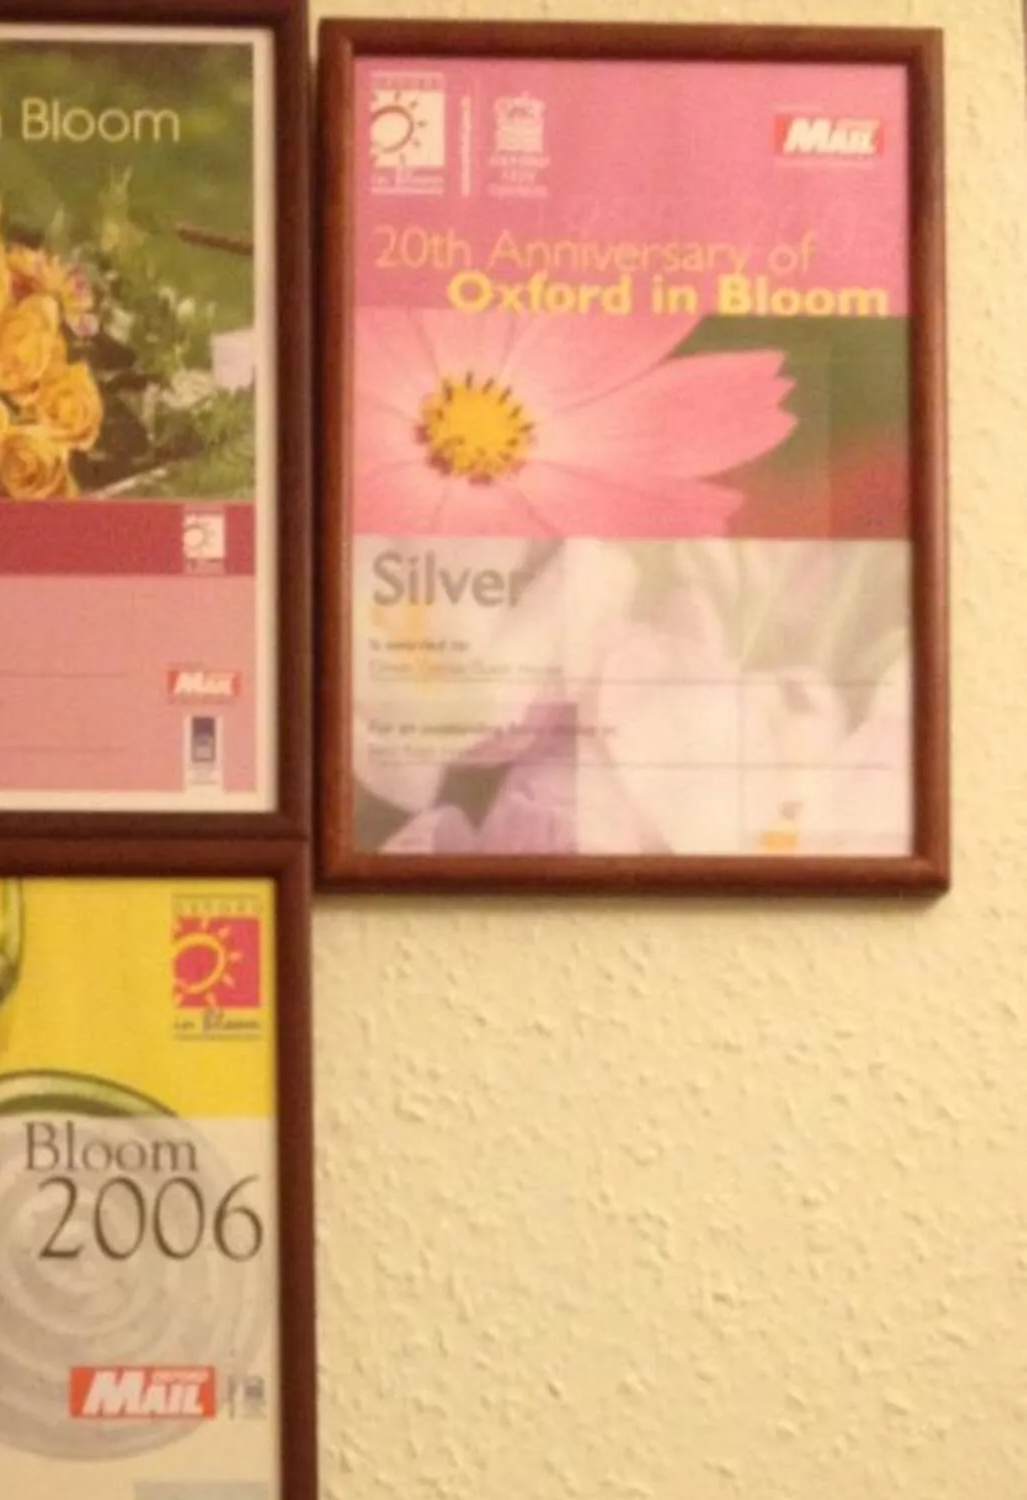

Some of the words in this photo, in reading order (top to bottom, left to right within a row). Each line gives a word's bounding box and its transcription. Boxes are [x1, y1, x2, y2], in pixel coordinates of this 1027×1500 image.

[21, 97, 181, 143] Bloom
[376, 226, 471, 270] 20th
[487, 229, 747, 277] Anniversary
[768, 231, 819, 274] of
[447, 269, 632, 316] Oxford
[652, 273, 696, 316] in
[718, 273, 890, 318] Bloom
[372, 550, 537, 609] Silver
[24, 1119, 200, 1174] Bloom
[37, 1174, 265, 1263] 2006
[83, 1371, 203, 1414] MAIL
